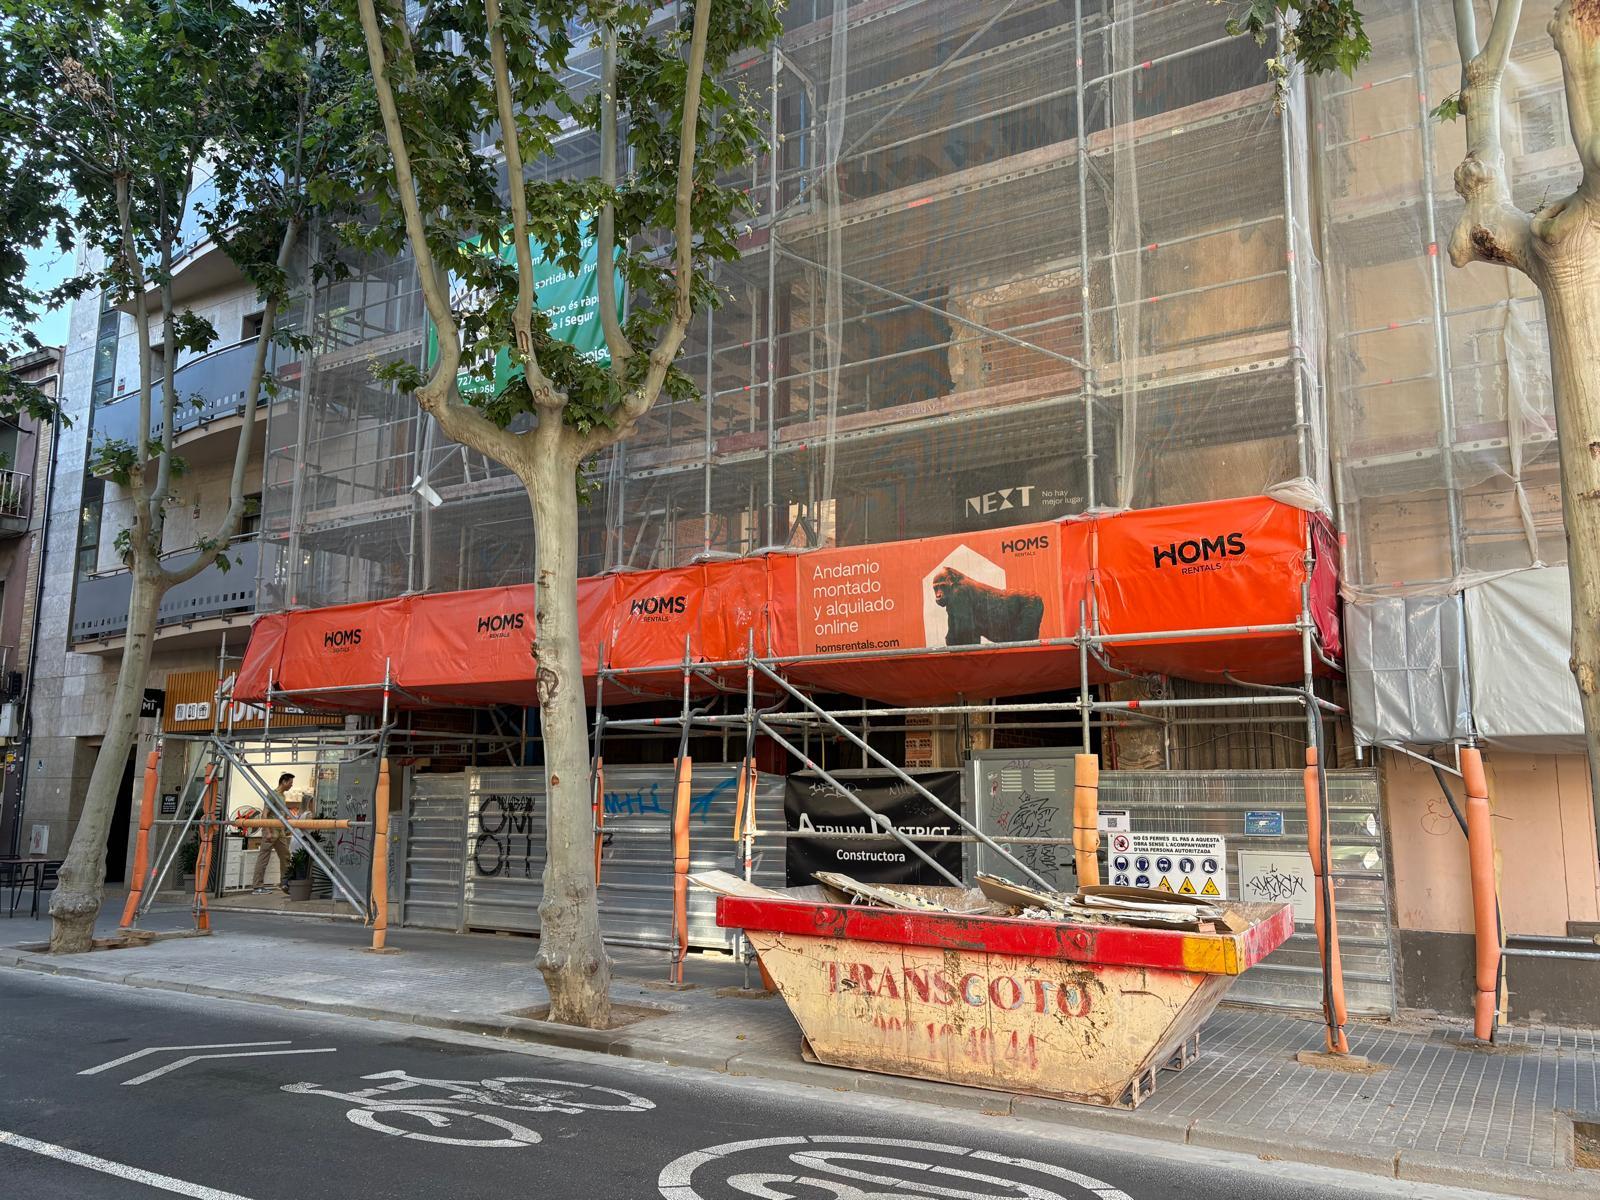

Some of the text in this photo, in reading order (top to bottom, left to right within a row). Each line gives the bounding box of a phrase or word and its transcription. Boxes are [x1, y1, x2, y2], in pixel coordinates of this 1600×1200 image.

[534, 272, 567, 290] sortida
[568, 299, 579, 310] és
[565, 311, 594, 326] Segur
[965, 485, 1068, 519] NEXT No hay
[1042, 496, 1084, 507] mejor lugar
[813, 558, 880, 581] Andamio
[1181, 562, 1222, 575] RENTALS
[813, 578, 881, 599] montado
[813, 595, 895, 621] y alquilado
[815, 619, 859, 636] online
[815, 639, 900, 653] homsrentals.com
[142, 702, 154, 711] MI
[836, 849, 906, 862] Constructora
[821, 960, 1093, 1018] TRANSCOTO
